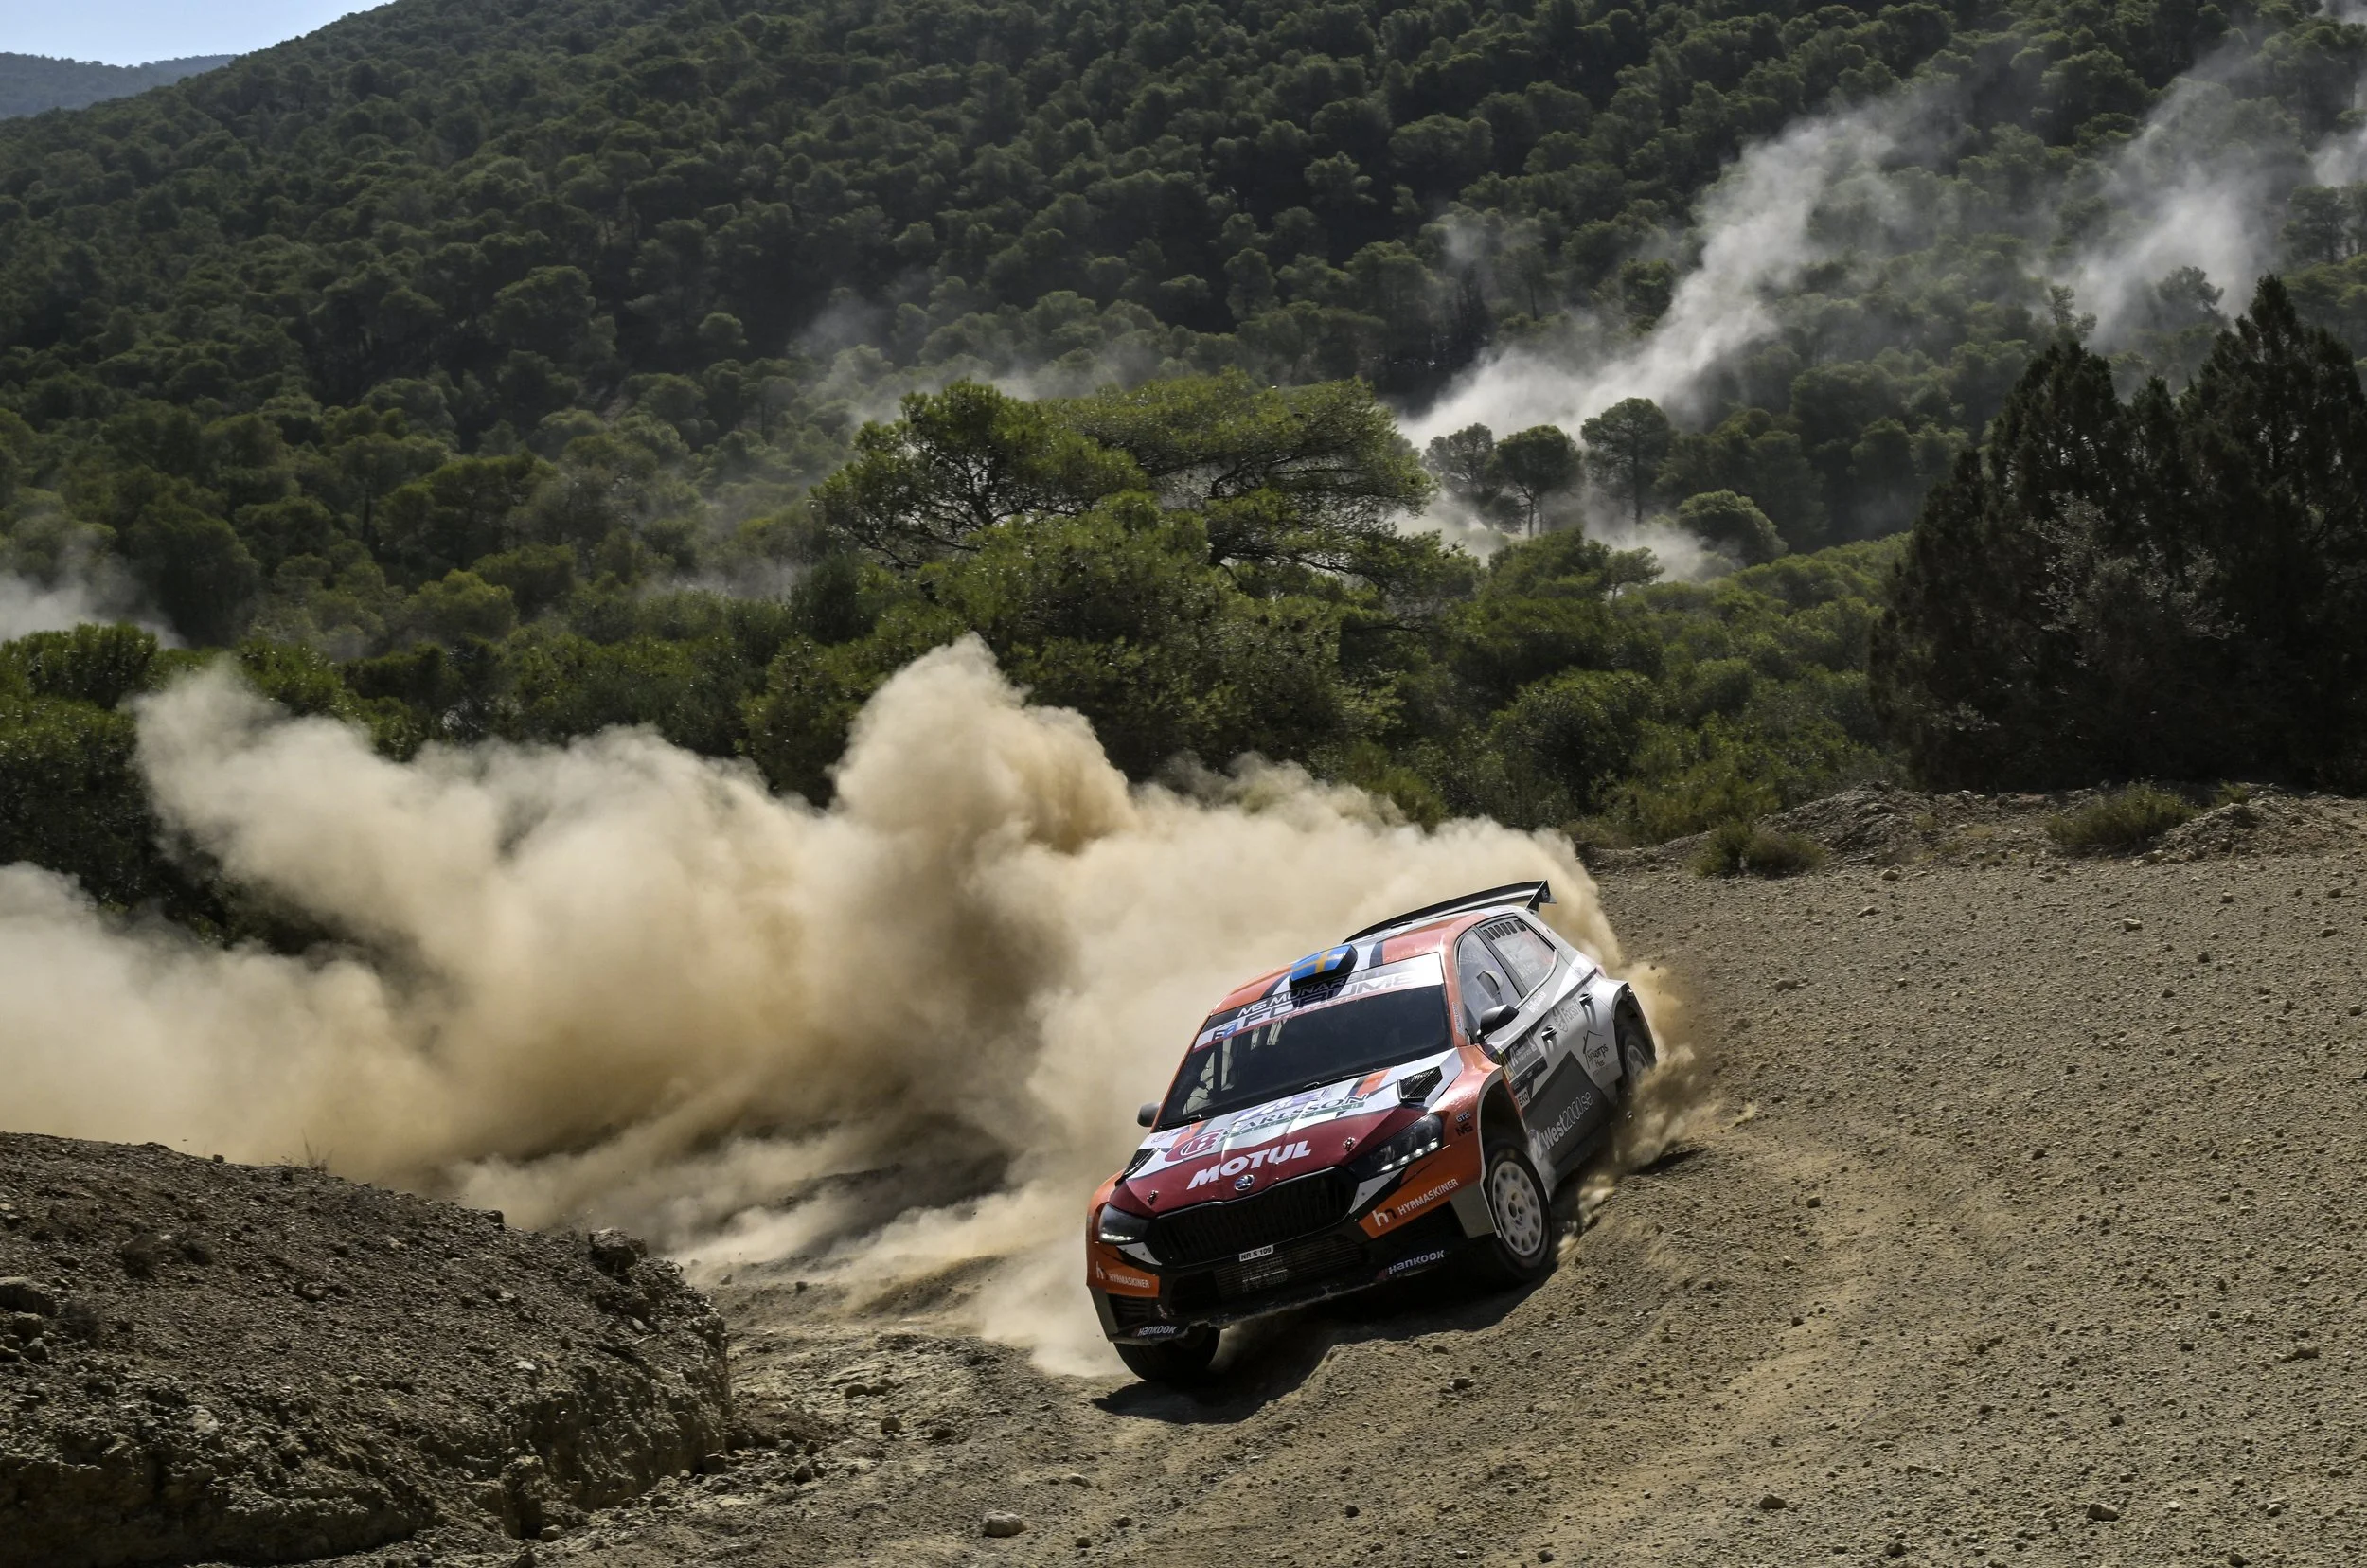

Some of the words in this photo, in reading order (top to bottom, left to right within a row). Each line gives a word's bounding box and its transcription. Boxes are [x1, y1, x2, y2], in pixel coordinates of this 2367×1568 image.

[1237, 1000, 1267, 1018] MS
[1518, 1091, 1529, 1106] EKO
[1541, 1092, 1593, 1149] West2000.se
[1186, 1141, 1311, 1190] MOTUL
[1397, 1178, 1459, 1215] HYRMASKINER
[1240, 1252, 1251, 1260] NR
[1259, 1247, 1272, 1256] 109
[1108, 1274, 1150, 1289] HYRMASKINER
